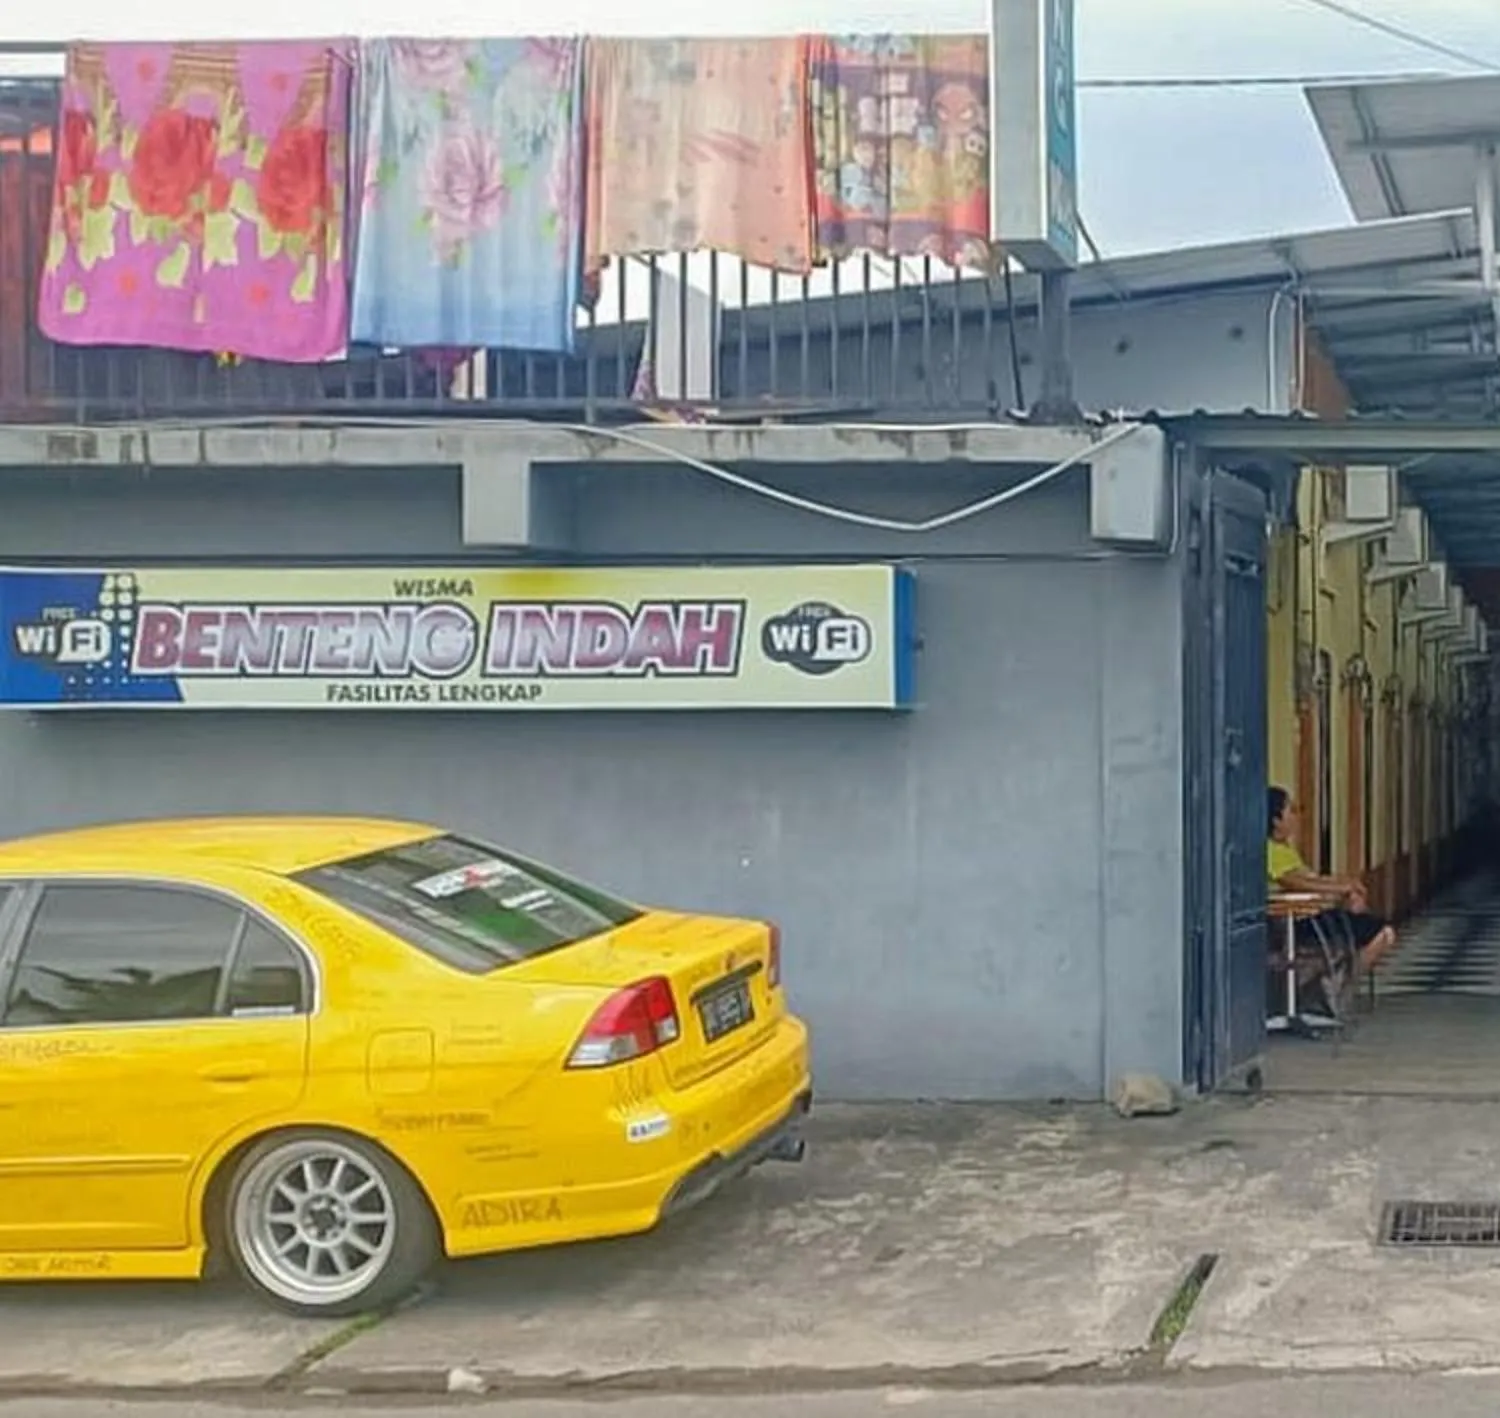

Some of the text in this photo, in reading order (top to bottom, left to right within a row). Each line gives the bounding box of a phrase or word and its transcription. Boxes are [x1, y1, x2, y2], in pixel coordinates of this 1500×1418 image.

[392, 579, 475, 597] WISMA
[132, 601, 745, 677] BENTENG INDAH
[326, 683, 542, 702] FASILITAS LENGKAP
[461, 1196, 563, 1229] ADIRA
